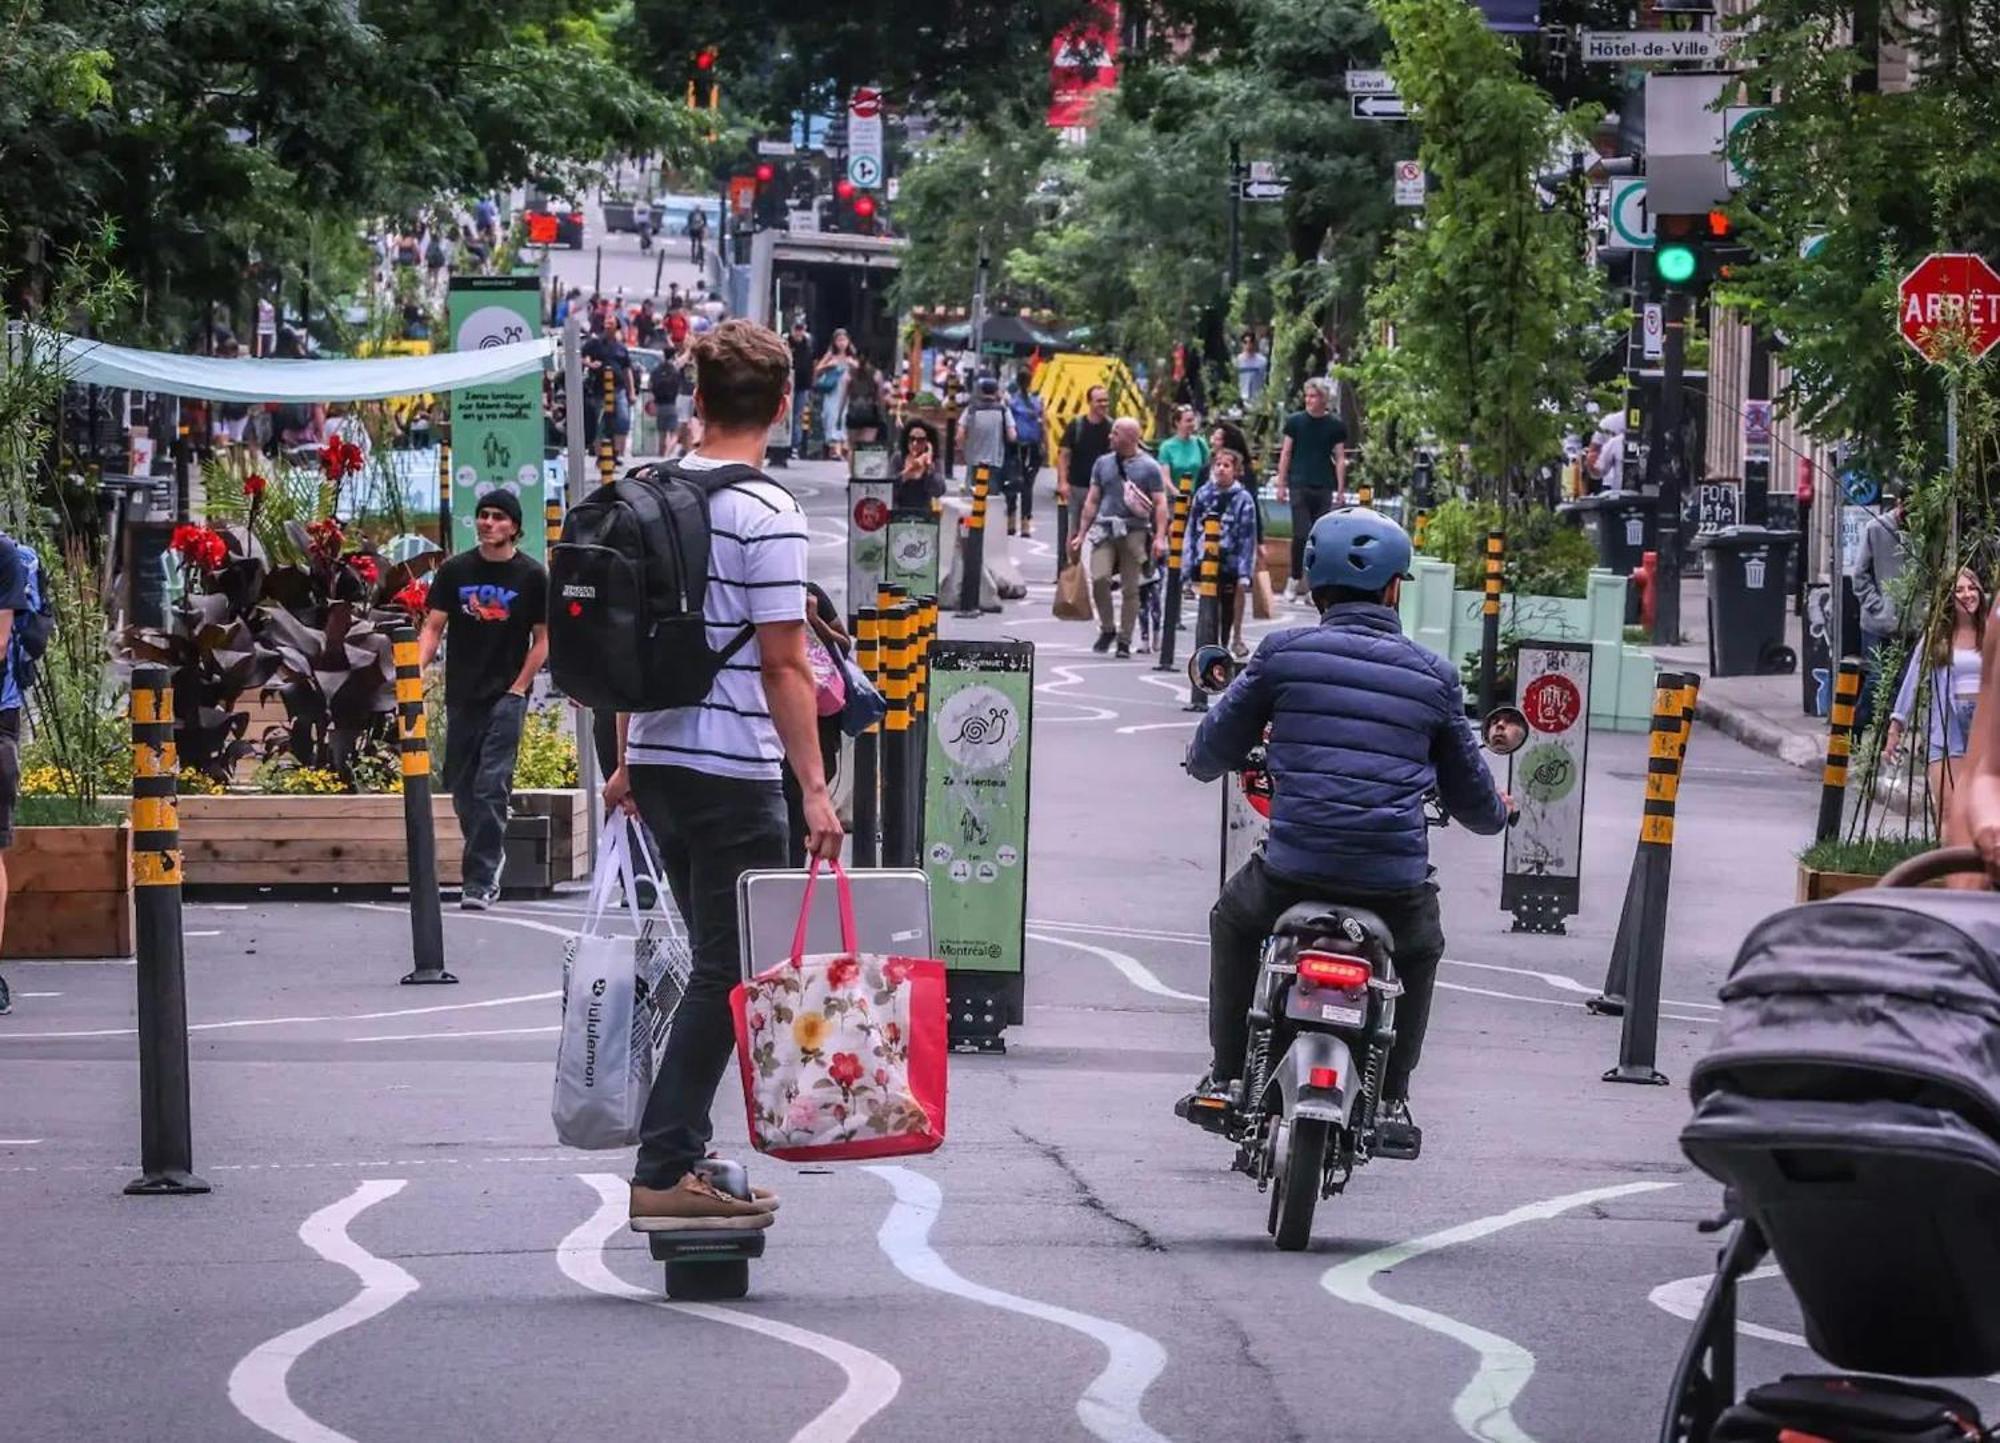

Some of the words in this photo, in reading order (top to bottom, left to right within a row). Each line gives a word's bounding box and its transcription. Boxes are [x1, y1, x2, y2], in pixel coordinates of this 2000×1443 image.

[1590, 41, 1709, 56] Hôtel-de-Ville
[1351, 78, 1384, 88] Laval
[1905, 288, 2000, 323] ARRÊT
[940, 944, 988, 956] Montréal
[585, 1002, 602, 1088] lululemon
